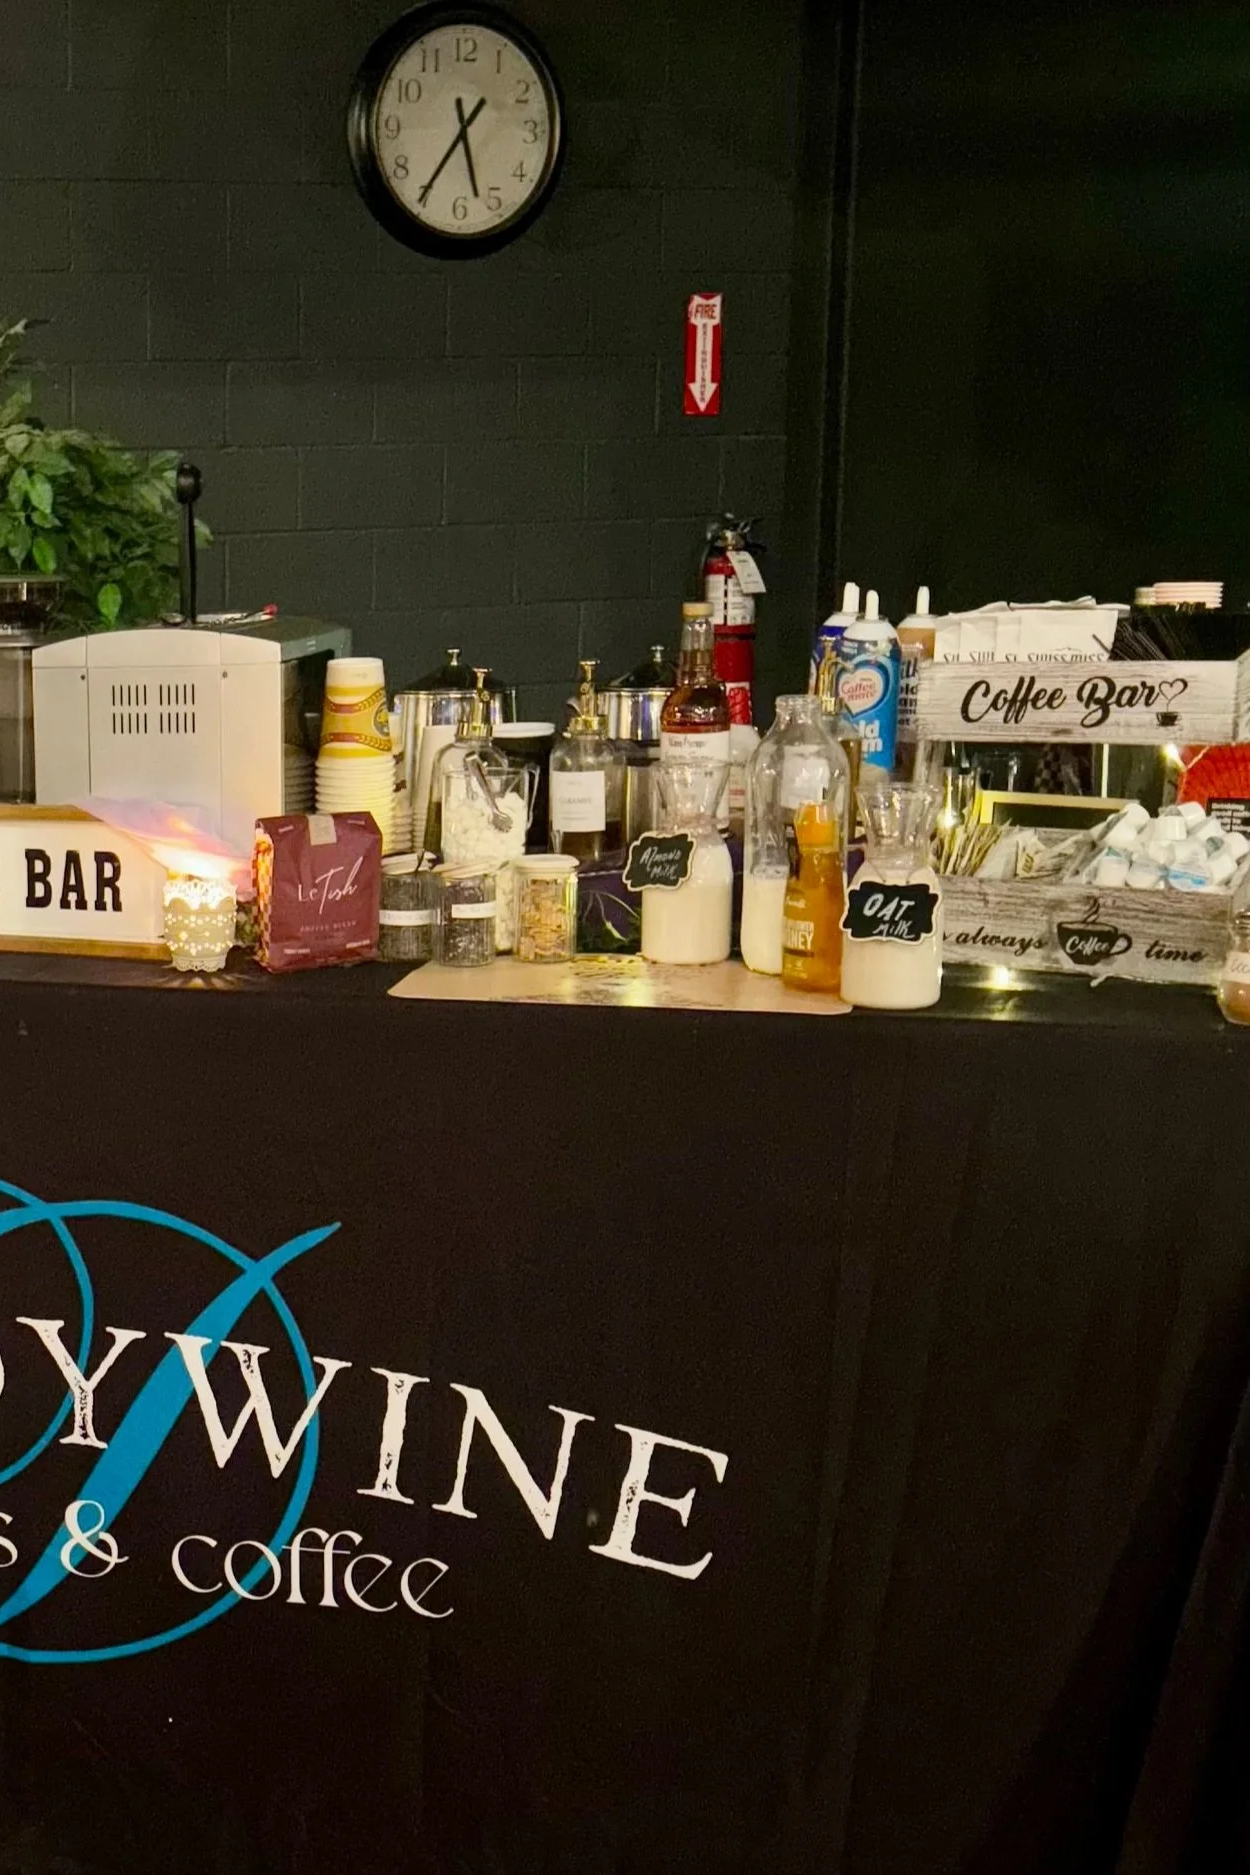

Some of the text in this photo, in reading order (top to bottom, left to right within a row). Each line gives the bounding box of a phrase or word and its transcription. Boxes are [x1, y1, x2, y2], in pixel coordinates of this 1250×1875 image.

[421, 48, 440, 73] 11
[455, 37, 478, 63] 12
[495, 49, 502, 74] 1
[399, 78, 422, 104] 10
[515, 79, 530, 104] 2
[384, 115, 401, 140] 9
[522, 119, 539, 145] 3
[393, 155, 410, 180] 8
[512, 159, 528, 183] 4
[452, 196, 469, 221] 6
[486, 186, 502, 212] 5
[694, 303, 717, 319] FIRE
[842, 680, 877, 697] Coffee
[961, 675, 1159, 728] Coffee Bar
[24, 848, 122, 912] BAR
[863, 893, 916, 921] OAT
[955, 925, 1207, 963] always Coffee time
[60, 1500, 129, 1579] &
[172, 1526, 454, 1618] coffee
